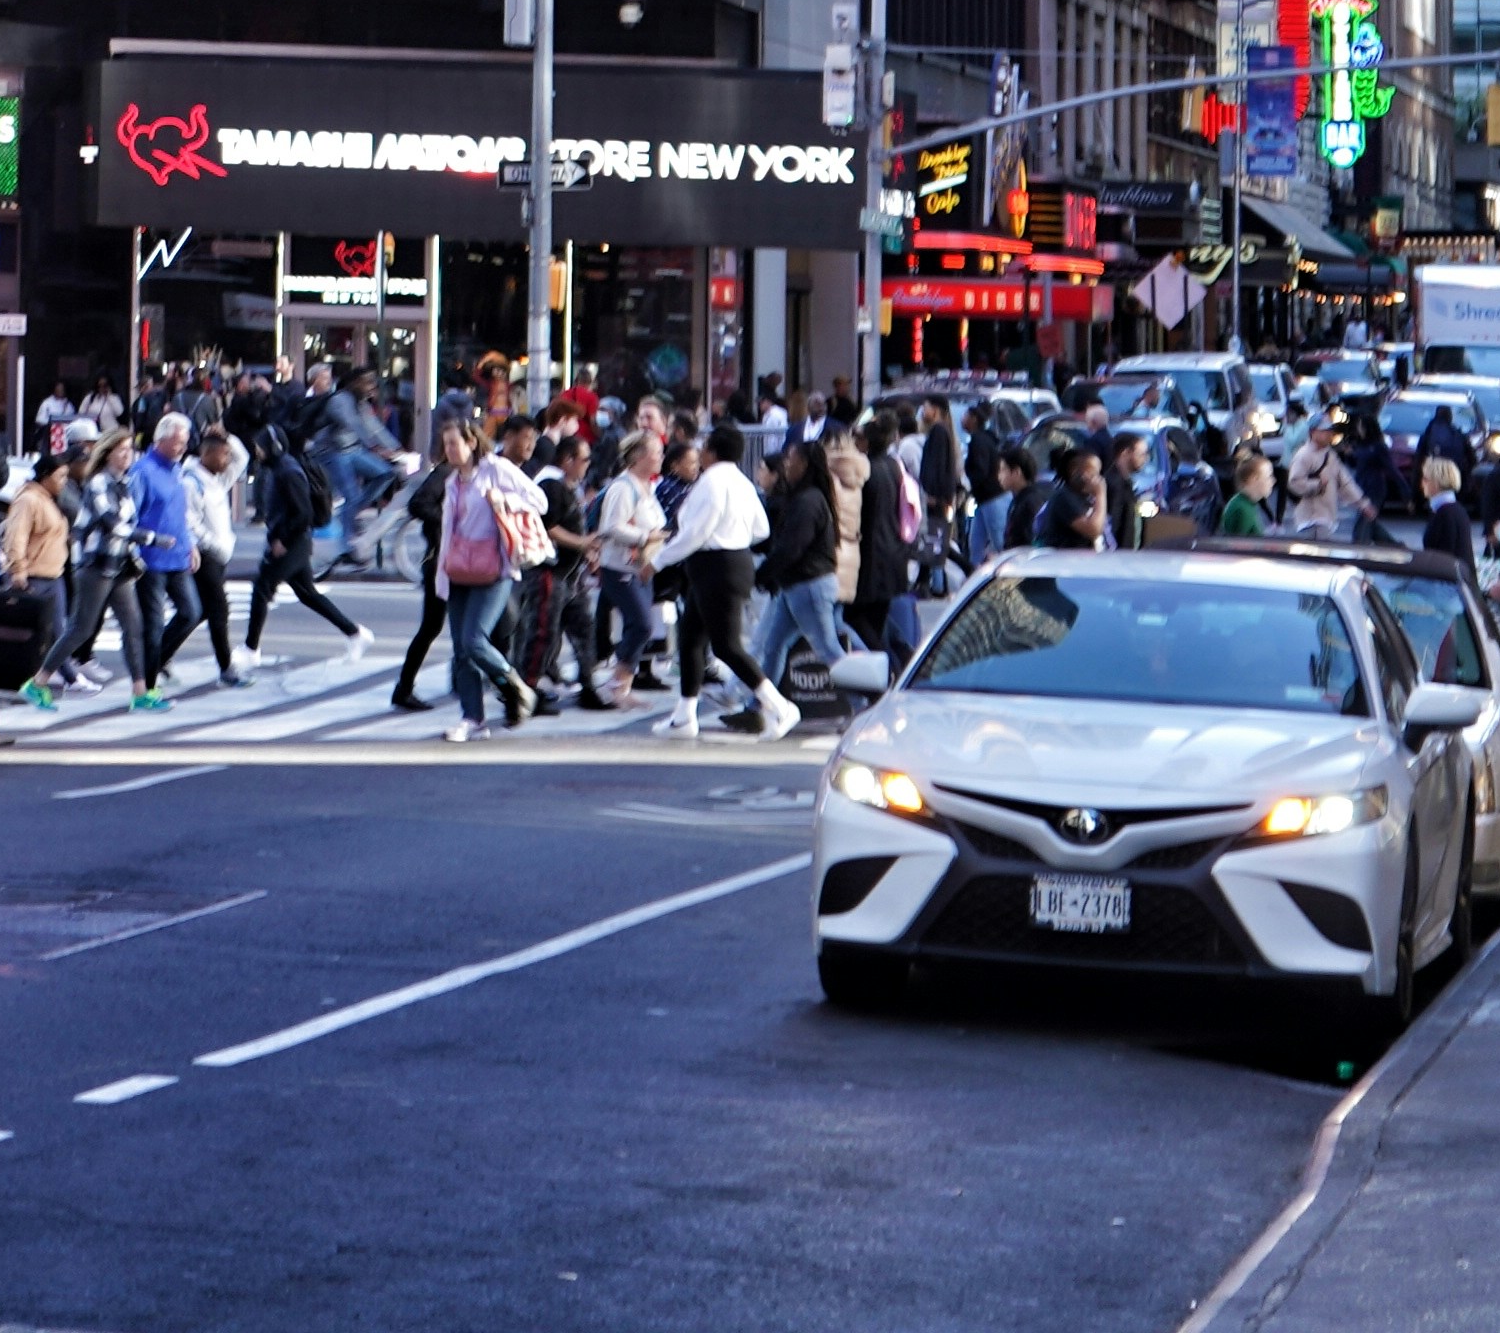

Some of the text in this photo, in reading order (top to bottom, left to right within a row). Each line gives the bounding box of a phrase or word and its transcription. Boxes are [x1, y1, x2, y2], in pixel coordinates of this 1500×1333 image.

[549, 138, 652, 182] TORE
[659, 141, 745, 181] NEW
[748, 144, 855, 185] YORK
